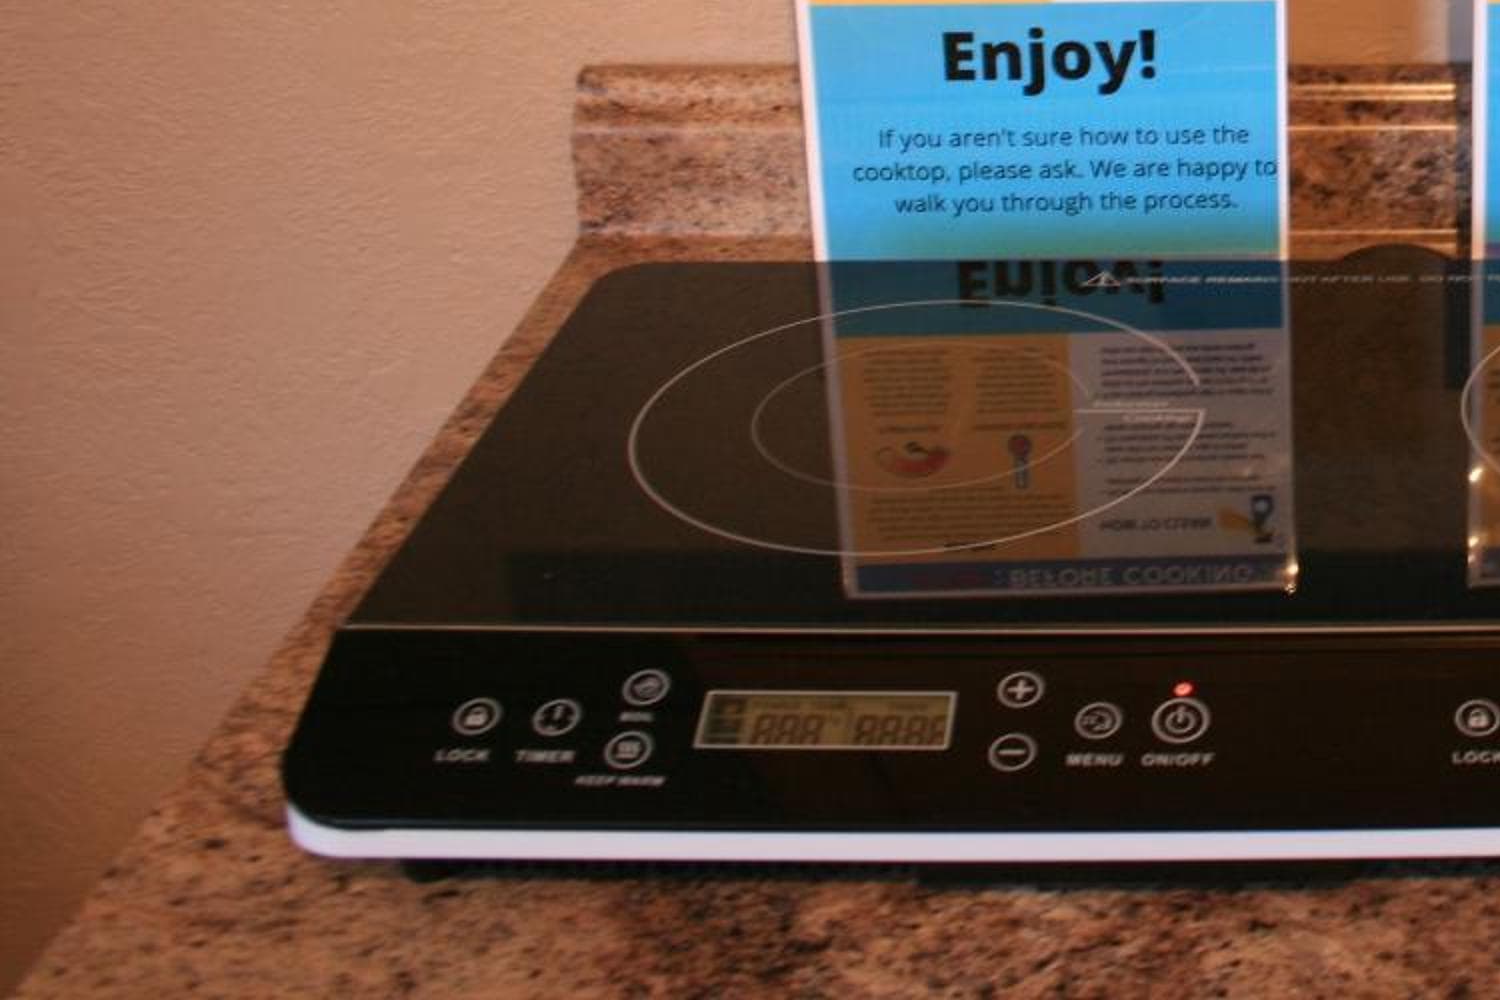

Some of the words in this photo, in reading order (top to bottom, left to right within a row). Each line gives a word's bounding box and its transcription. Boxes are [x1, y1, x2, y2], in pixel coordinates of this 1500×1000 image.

[942, 27, 1157, 96] Enjoy!
[879, 130, 898, 148] If
[900, 132, 942, 153] you
[950, 127, 1016, 148] aren't
[1022, 130, 1073, 147] sure
[1080, 127, 1129, 146] how
[1136, 128, 1159, 145] to
[1166, 130, 1205, 145] use
[1213, 125, 1250, 144] the
[852, 160, 951, 186] cooktop,
[959, 161, 1034, 185] please
[1039, 161, 1083, 180] ask.
[1090, 160, 1127, 179] We
[1133, 163, 1169, 178] are
[1176, 158, 1248, 183] happy
[1255, 159, 1278, 175] to
[895, 194, 947, 214] walk
[952, 196, 995, 218] you
[1001, 193, 1093, 217] through
[1100, 191, 1137, 211] the
[1144, 192, 1238, 216] process.
[434, 748, 489, 762] LOCK
[514, 749, 576, 763] TIMER
[1065, 753, 1124, 767] MENU
[1140, 752, 1215, 767] ON/OFF
